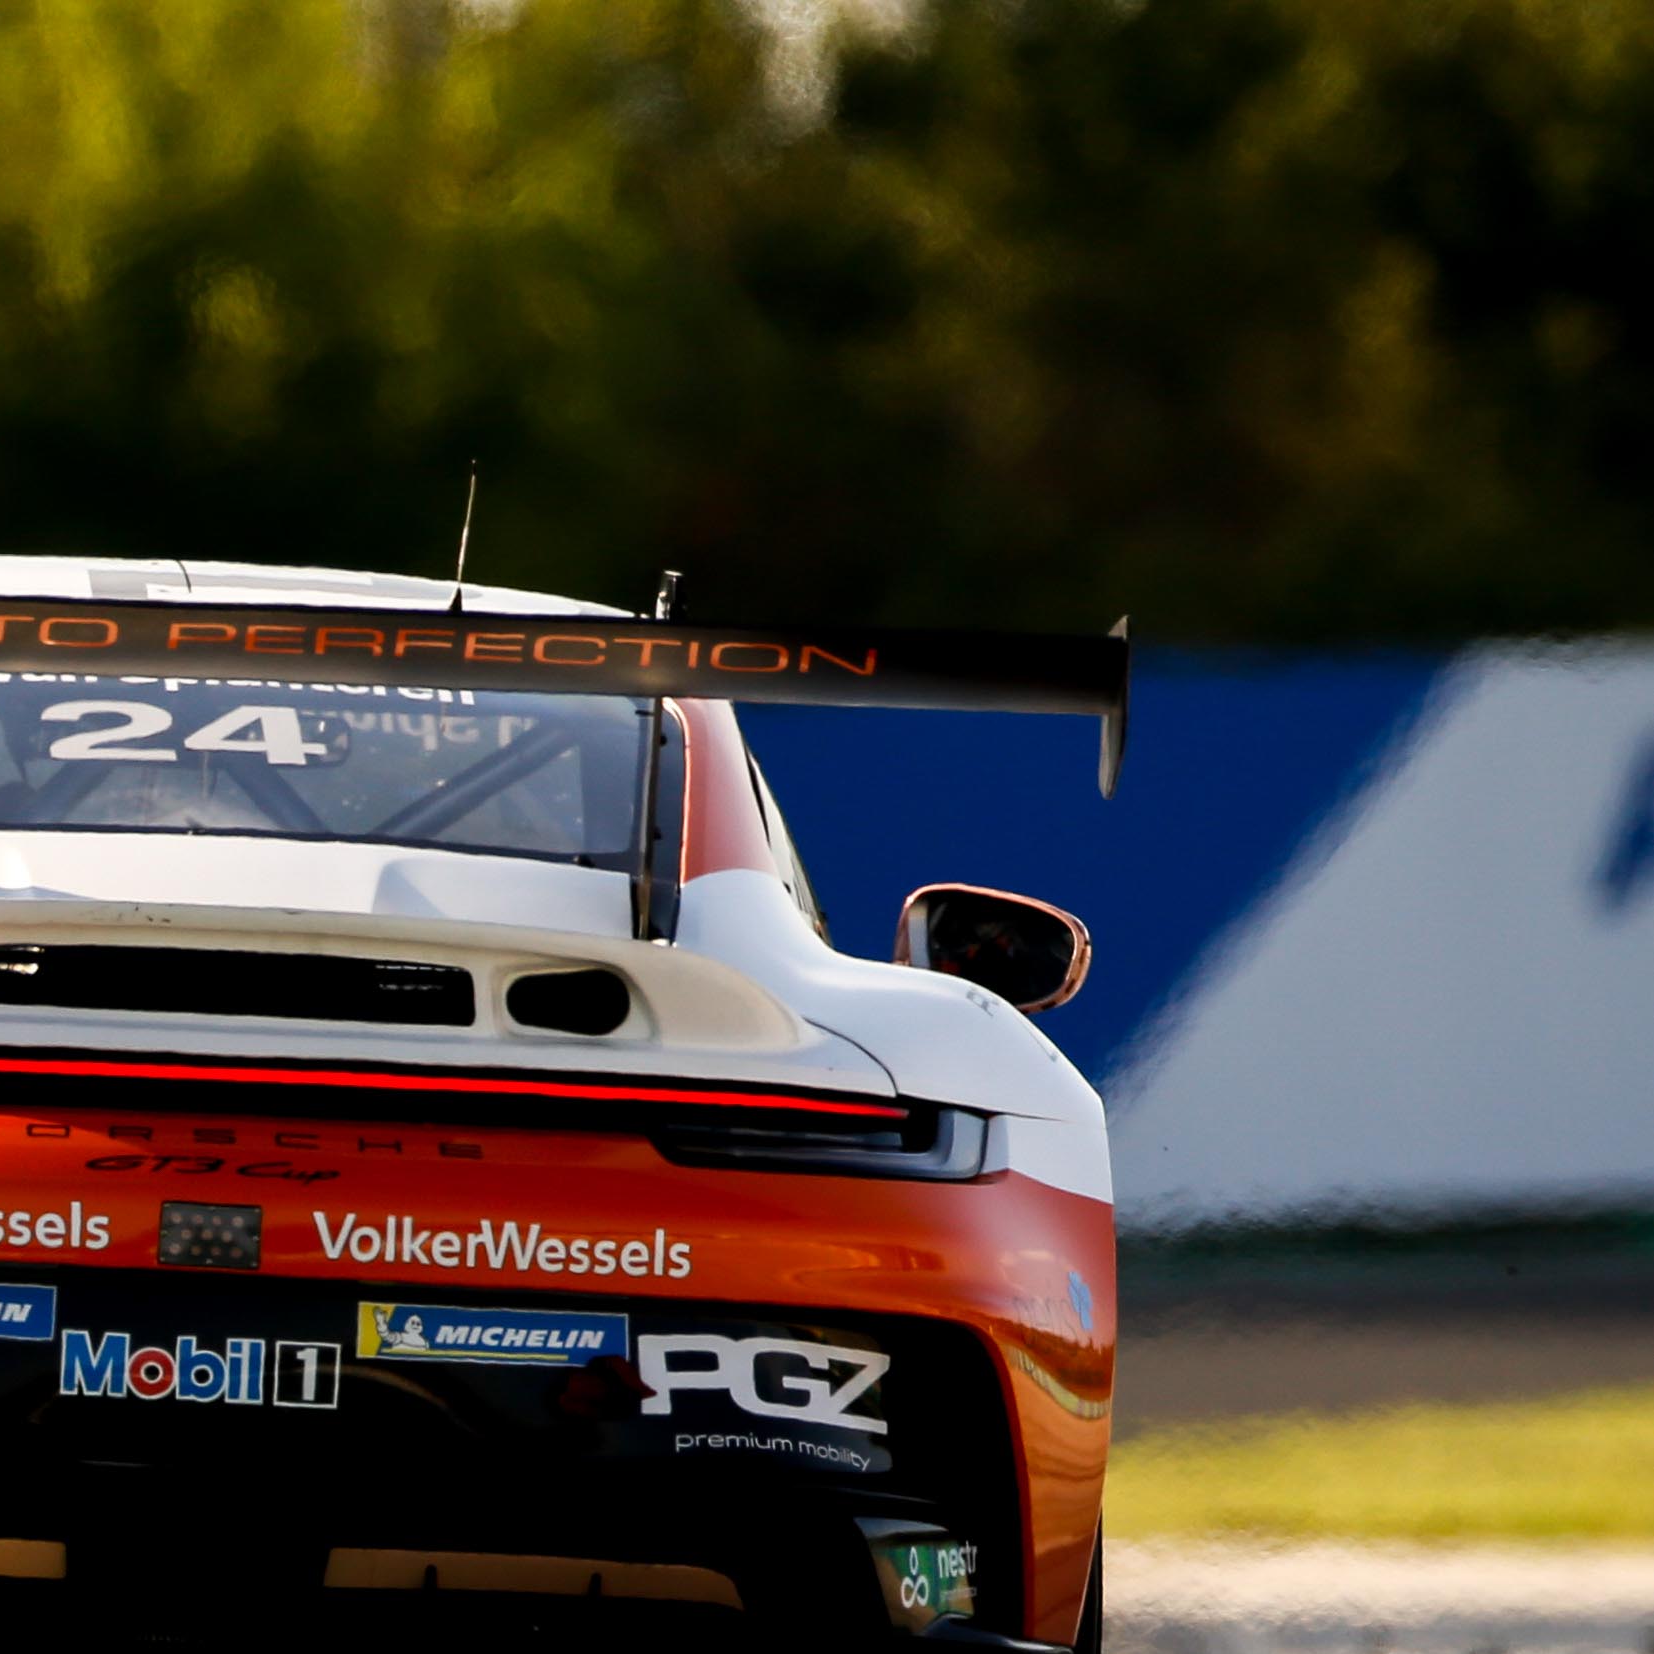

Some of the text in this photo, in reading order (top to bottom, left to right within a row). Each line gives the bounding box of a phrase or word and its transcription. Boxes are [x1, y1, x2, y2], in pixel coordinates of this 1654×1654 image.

[166, 622, 878, 677] PERFECTION
[41, 700, 327, 765] 24
[86, 1154, 341, 1186] GT3 Cup
[312, 1210, 692, 1279] VolkerWessels
[434, 1325, 606, 1349] MICHELIN
[60, 1329, 266, 1404] Mobil
[637, 1334, 891, 1435] PGZ
[675, 1431, 871, 1471] premium mobility
[937, 1540, 977, 1579] nestr
